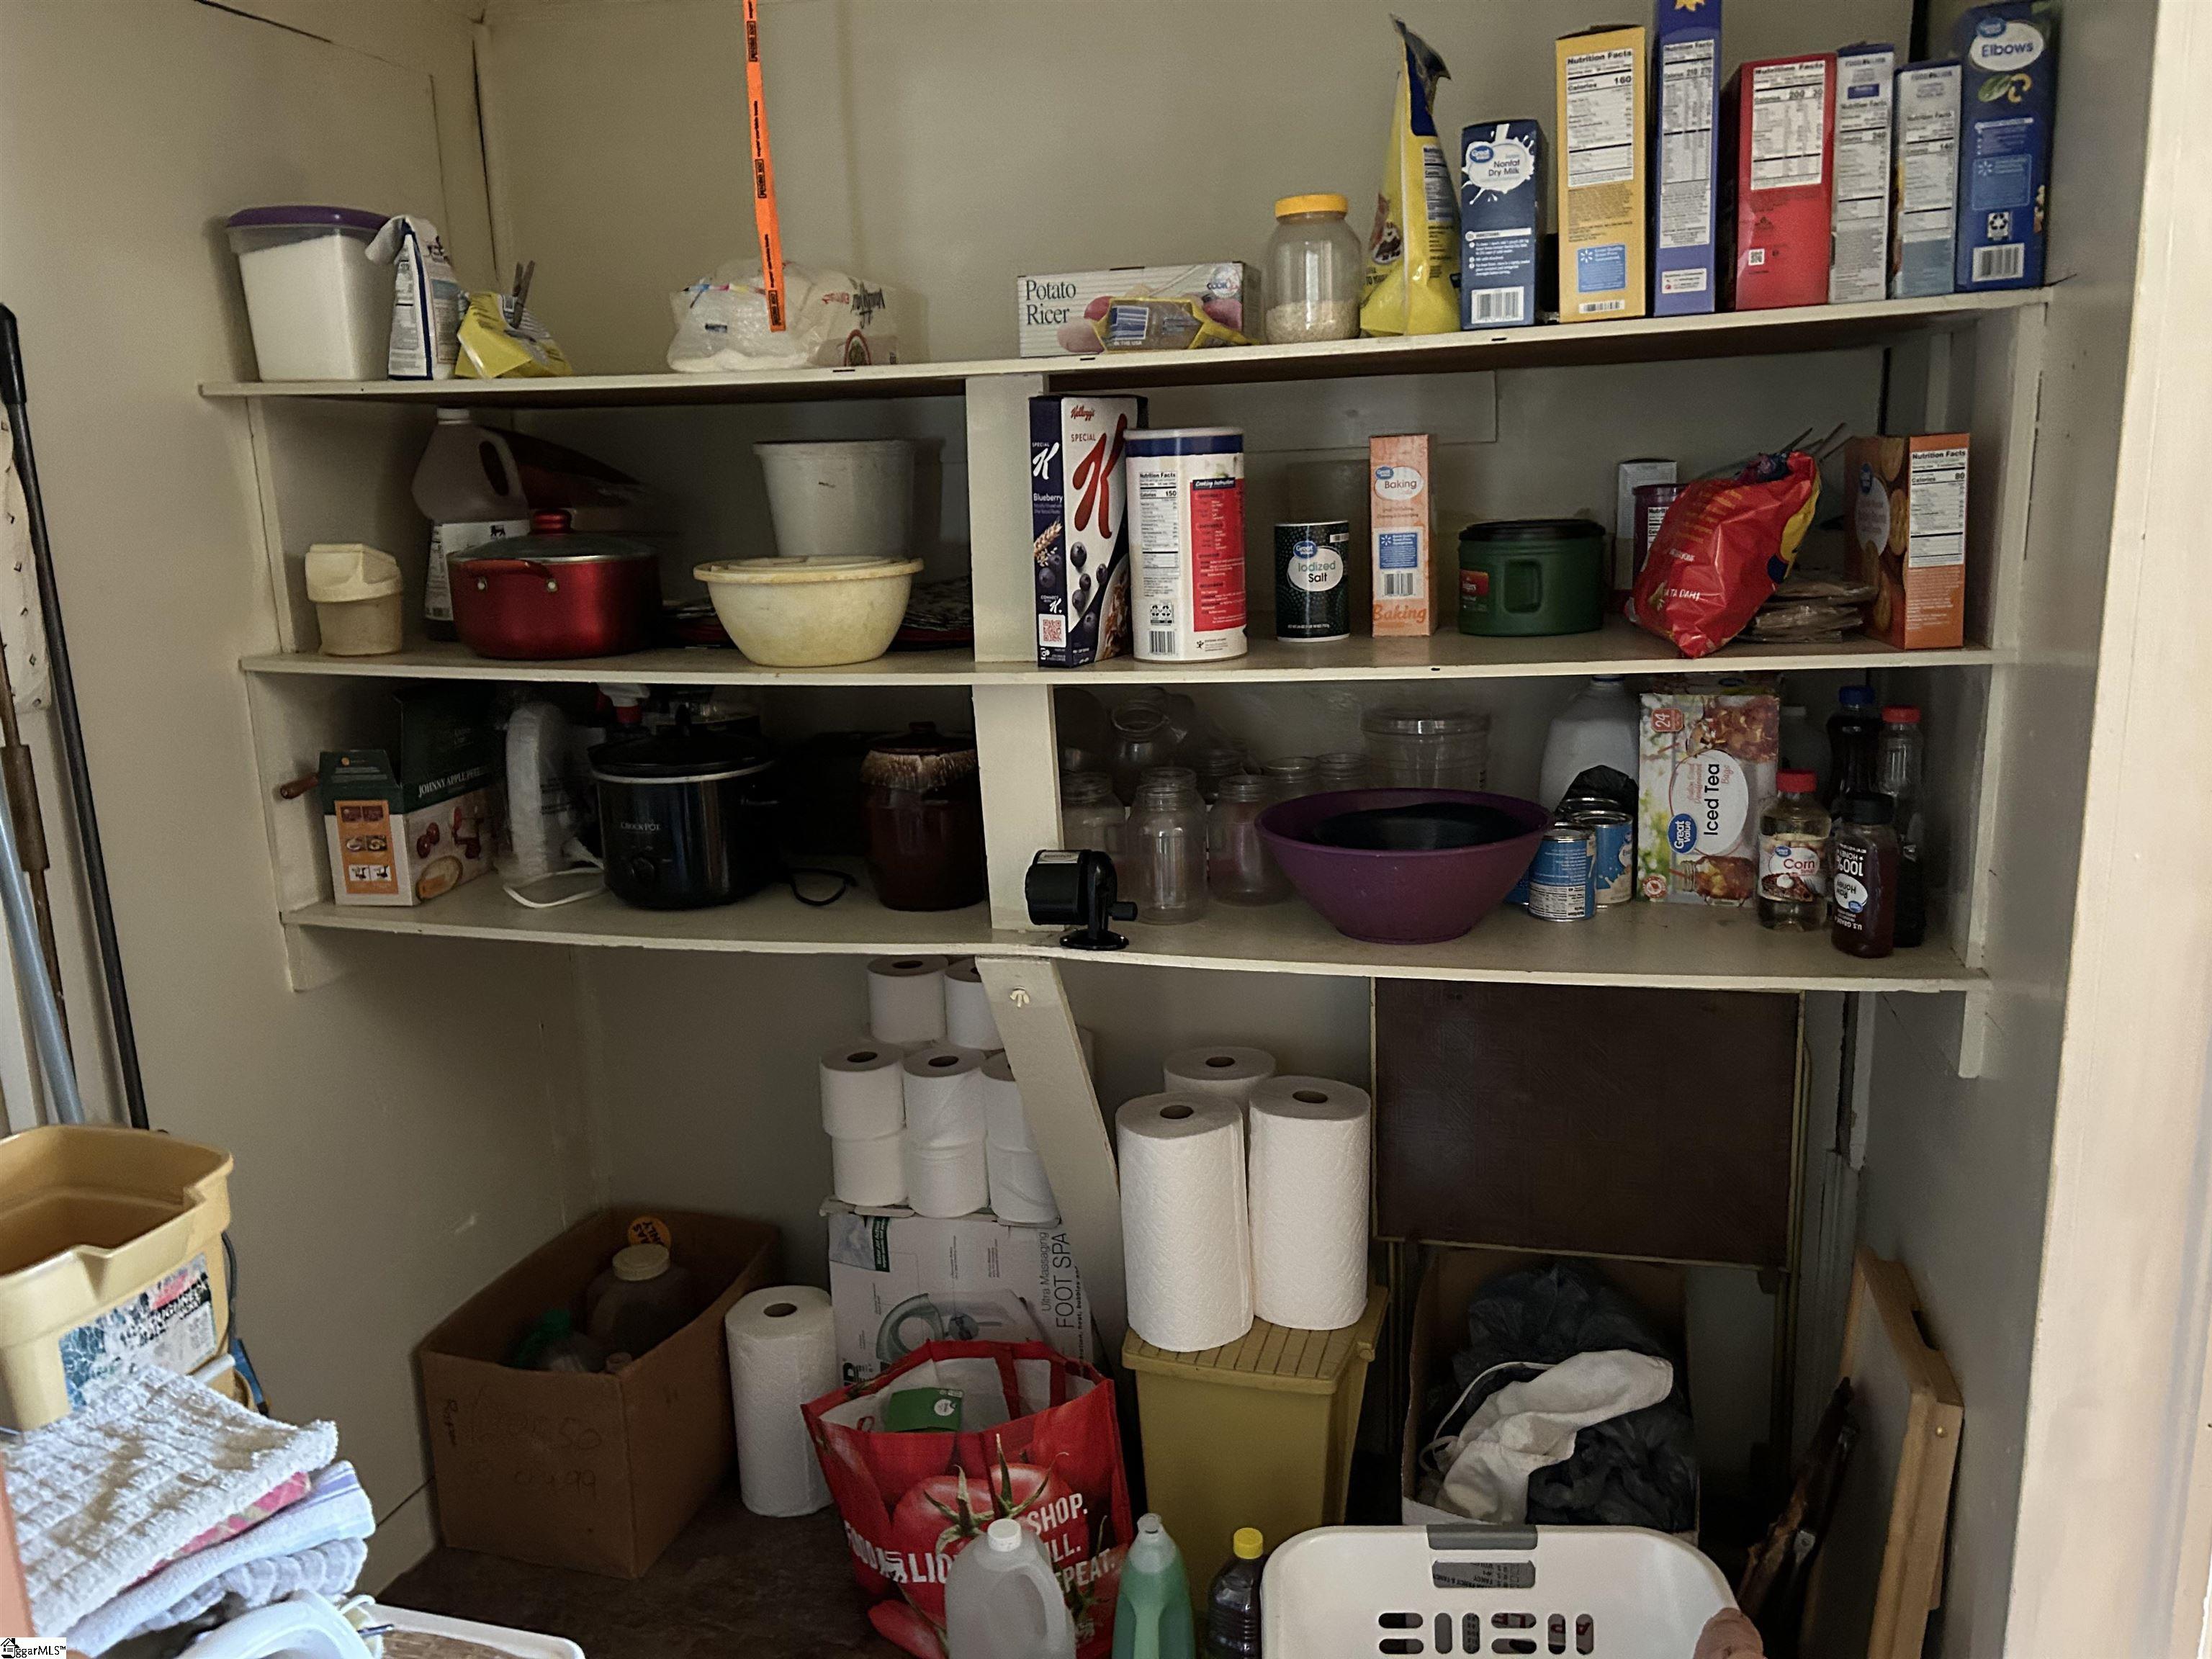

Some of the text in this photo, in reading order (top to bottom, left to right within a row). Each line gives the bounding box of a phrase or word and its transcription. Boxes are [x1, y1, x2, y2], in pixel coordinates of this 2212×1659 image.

[1568, 50, 1632, 65] Nutrition Facts
[1982, 42, 2033, 58] Elbows
[1614, 76, 1632, 84] 160
[1493, 159, 1520, 168] Nonfat
[1025, 279, 1076, 301] Potato
[1026, 303, 1070, 325] Ricer
[1071, 405, 1095, 421] Kellogg's
[1071, 433, 1096, 442] SPECIAL
[1033, 441, 1060, 480] K
[1072, 413, 1128, 539] K
[1384, 480, 1417, 490] Baking
[1033, 493, 1063, 504] Blueberry
[1298, 561, 1336, 572] Iodized
[1308, 572, 1328, 583] Salt
[1373, 604, 1427, 624] Baking
[1655, 713, 1671, 729] 24
[418, 778, 446, 798] JOHNNY
[446, 772, 467, 786] APPLE
[1704, 763, 1720, 835] Iced Tea
[1673, 820, 1685, 850] Great
[1683, 819, 1692, 843] Value
[1783, 858, 1815, 870] Corn
[1039, 1231, 1051, 1312] Ultra Massaging
[1051, 1233, 1074, 1328] FOOT SPA
[1026, 1493, 1089, 1536] SHOP.
[1045, 1532, 1081, 1563] ILL.
[908, 1552, 955, 1584] LIO
[1053, 1548, 1115, 1593] PEAT.
